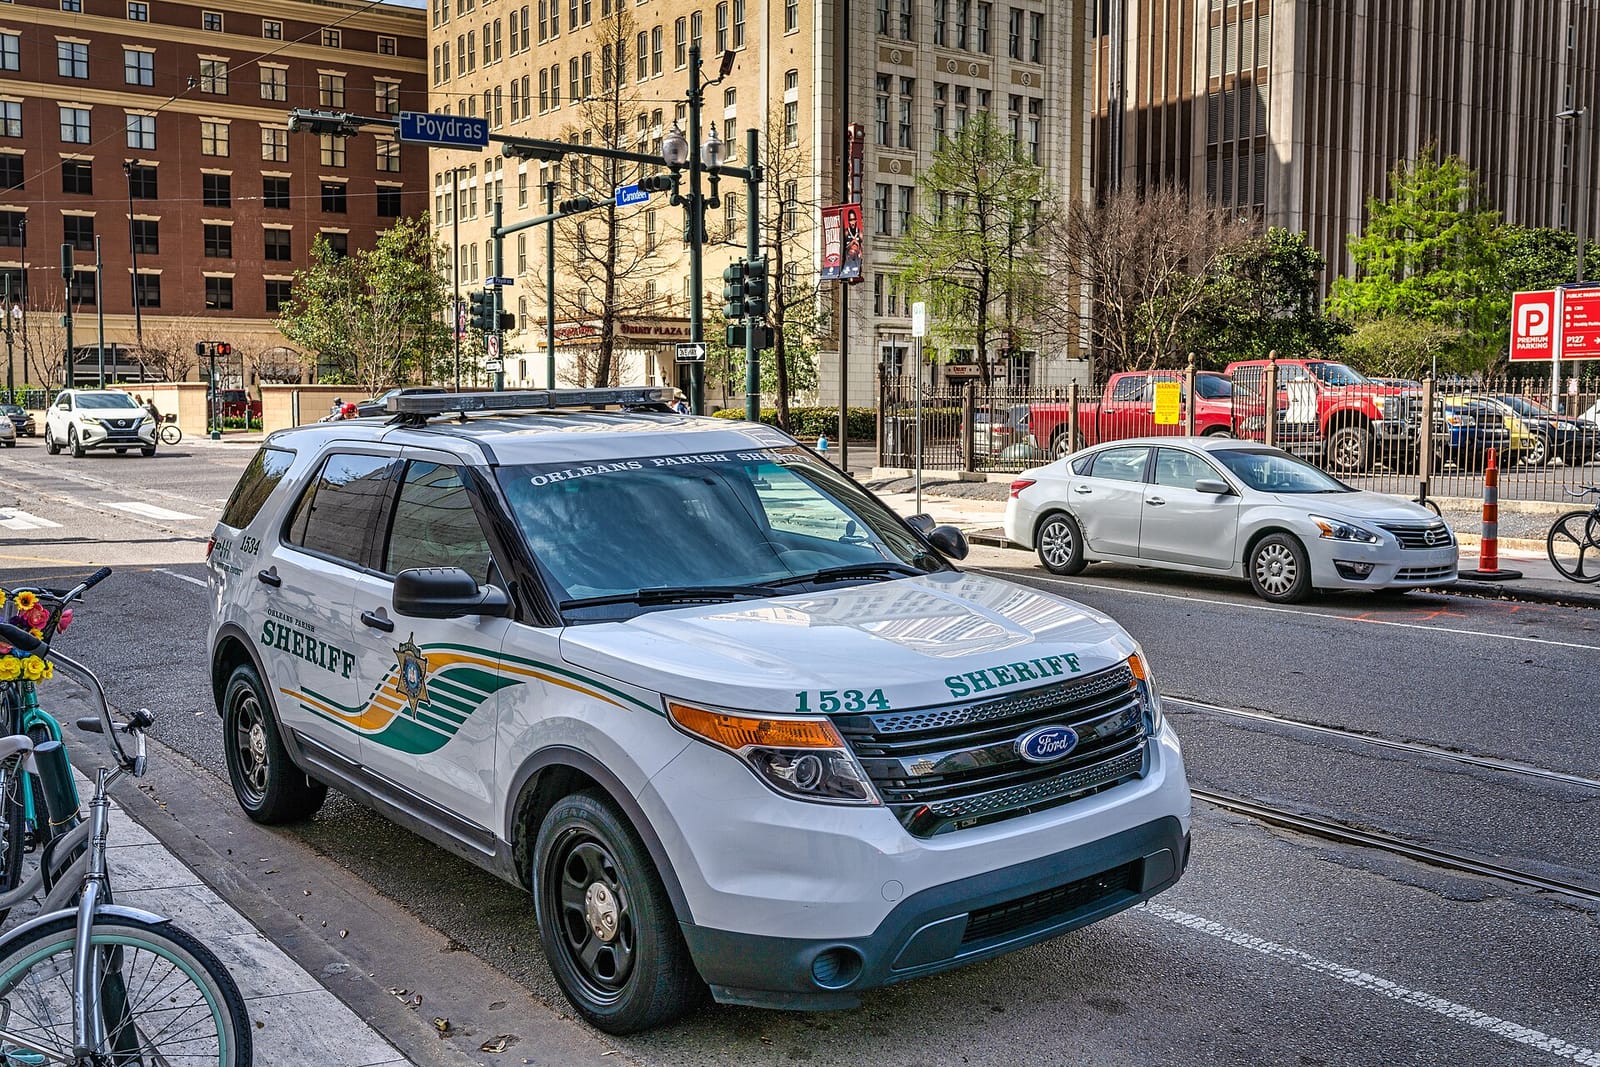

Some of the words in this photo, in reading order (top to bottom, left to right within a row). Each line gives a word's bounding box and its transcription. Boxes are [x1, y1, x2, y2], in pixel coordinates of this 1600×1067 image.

[416, 115, 482, 140] Poydras
[654, 327, 682, 336] PLAZA
[1517, 342, 1548, 350] PARKING
[530, 460, 643, 487] ORLEANS
[652, 453, 731, 468] PARISH
[240, 535, 260, 556] 1534
[267, 608, 293, 623] ORLEANS
[294, 619, 315, 633] PARISH
[261, 619, 355, 679] SHERIFF
[795, 688, 891, 713] 1534
[944, 652, 1081, 698] SHERIFF
[1037, 732, 1068, 755] Ford
